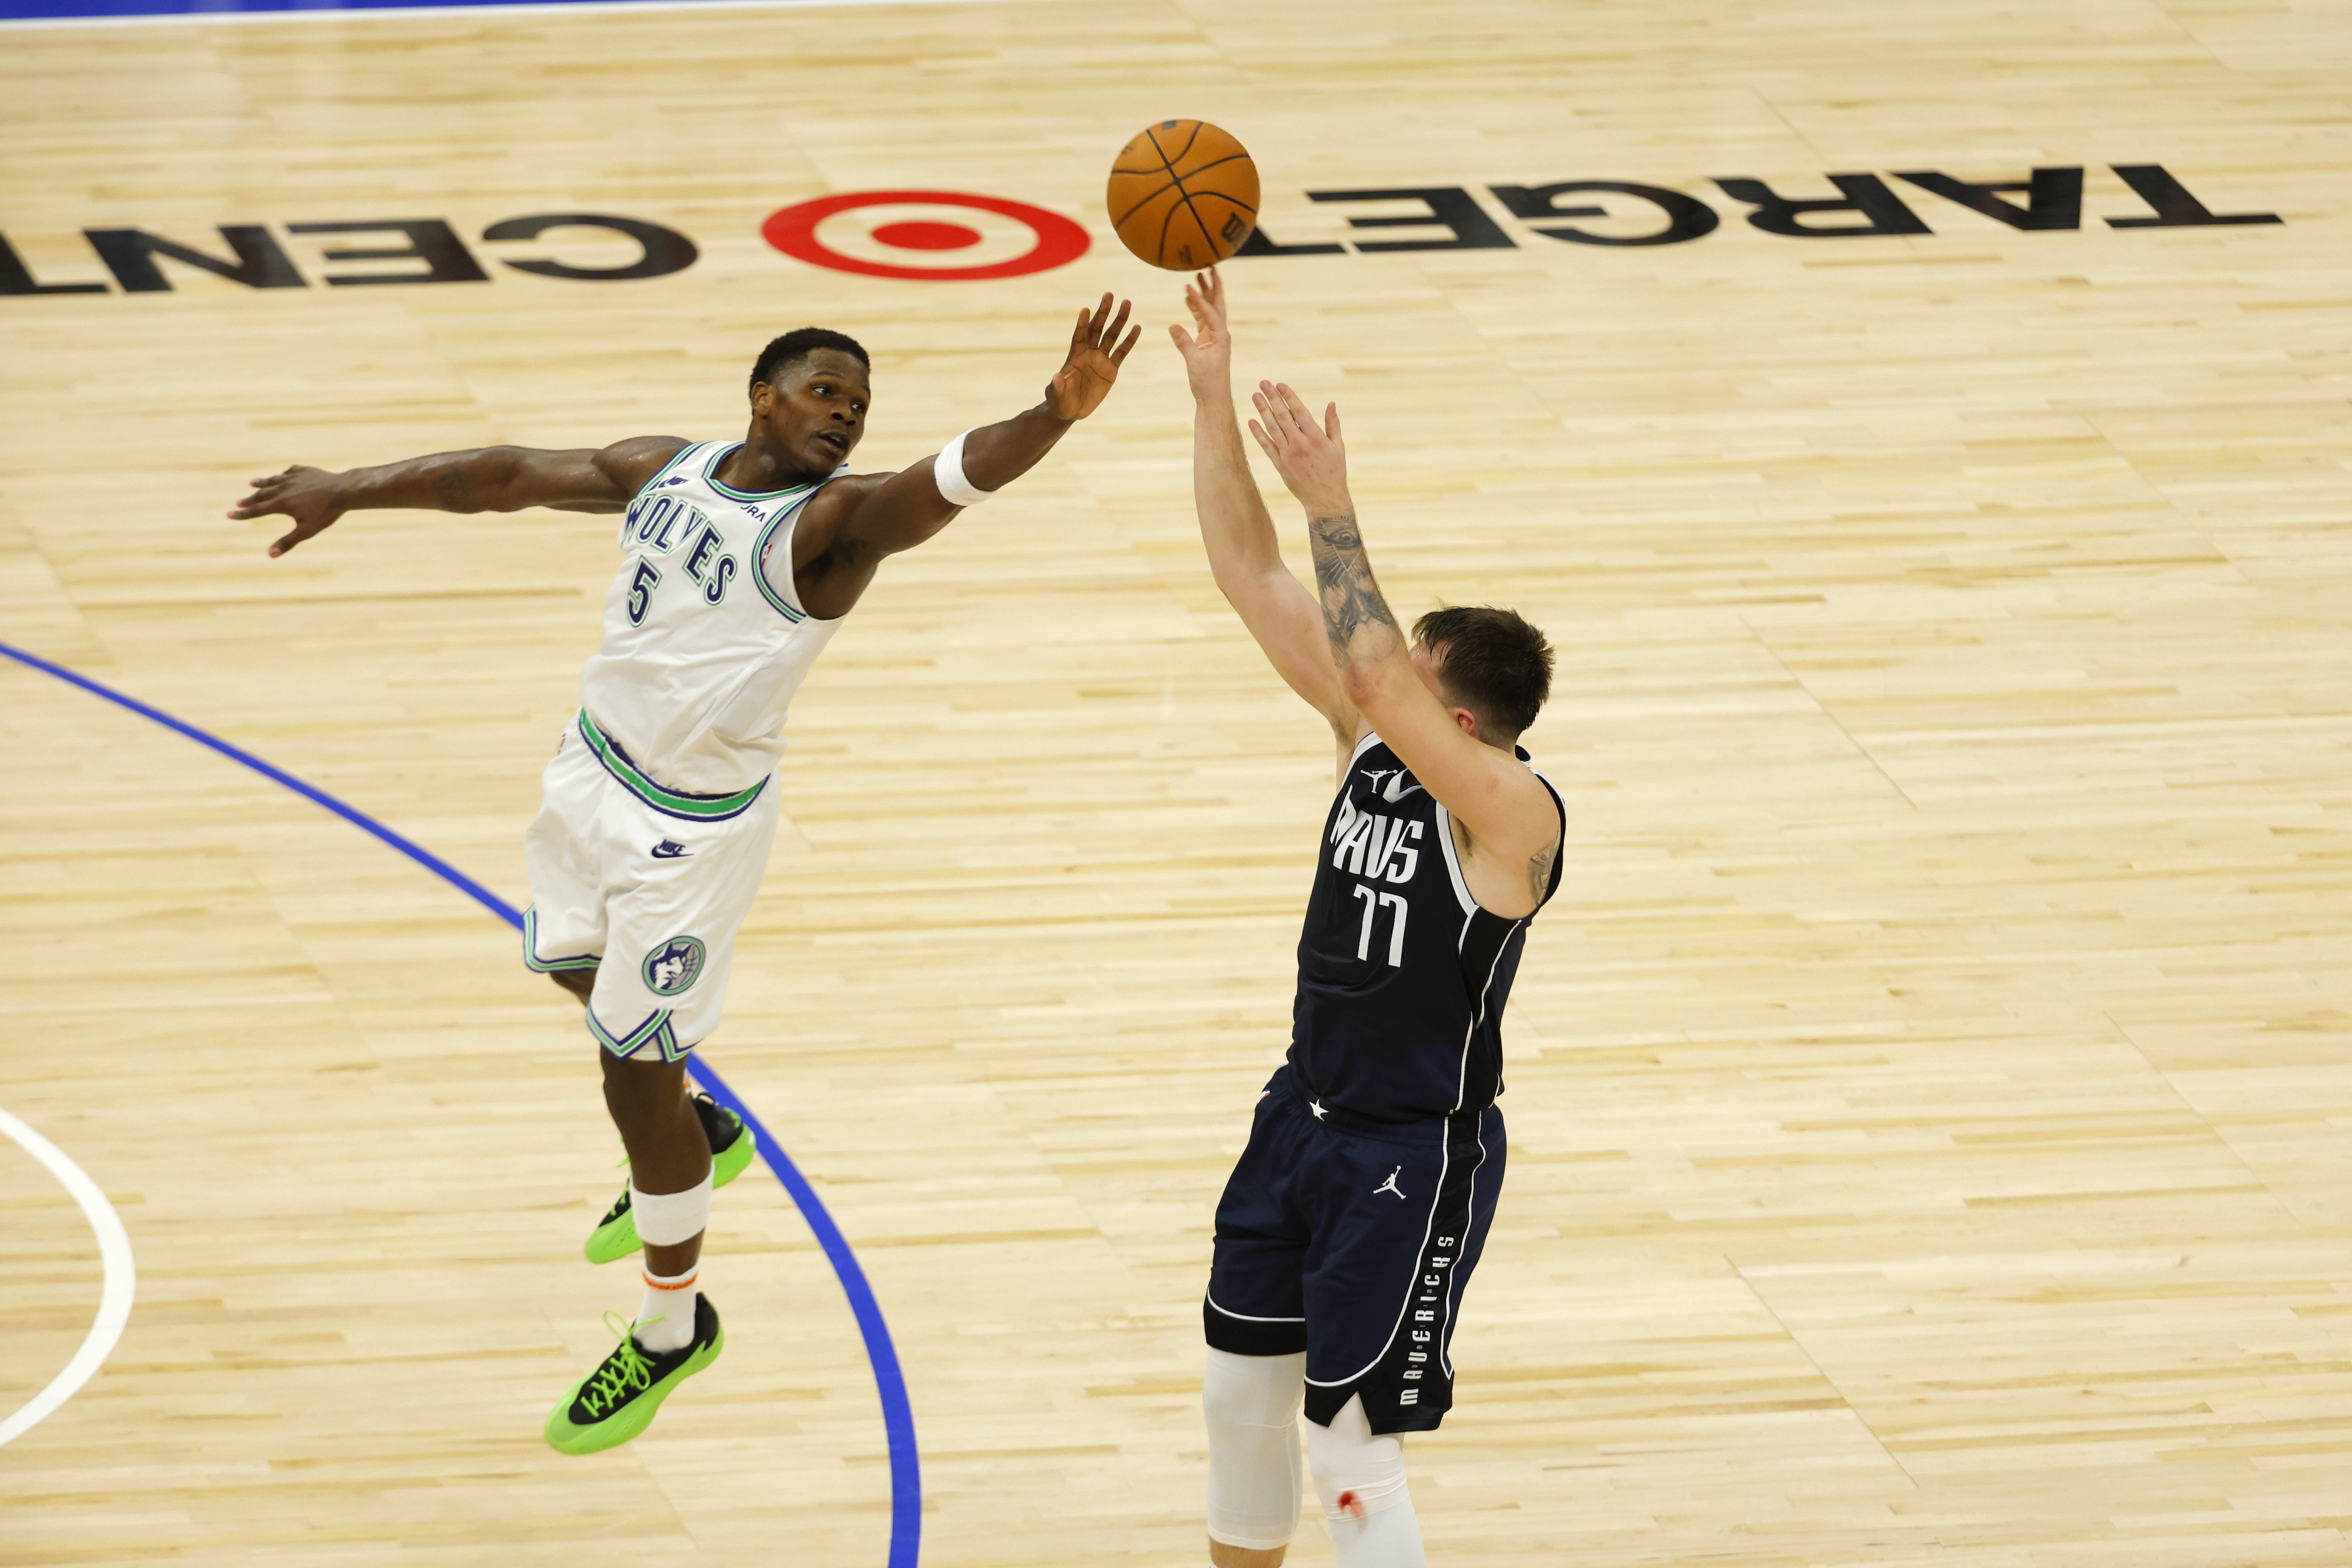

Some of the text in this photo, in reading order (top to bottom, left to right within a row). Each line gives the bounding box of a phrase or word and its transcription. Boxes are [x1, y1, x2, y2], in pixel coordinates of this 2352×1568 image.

[621, 494, 737, 606] WOLVES
[627, 554, 663, 628] 5
[1353, 884, 1408, 968] 77
[1400, 1236, 1454, 1405] MAVERICKS
